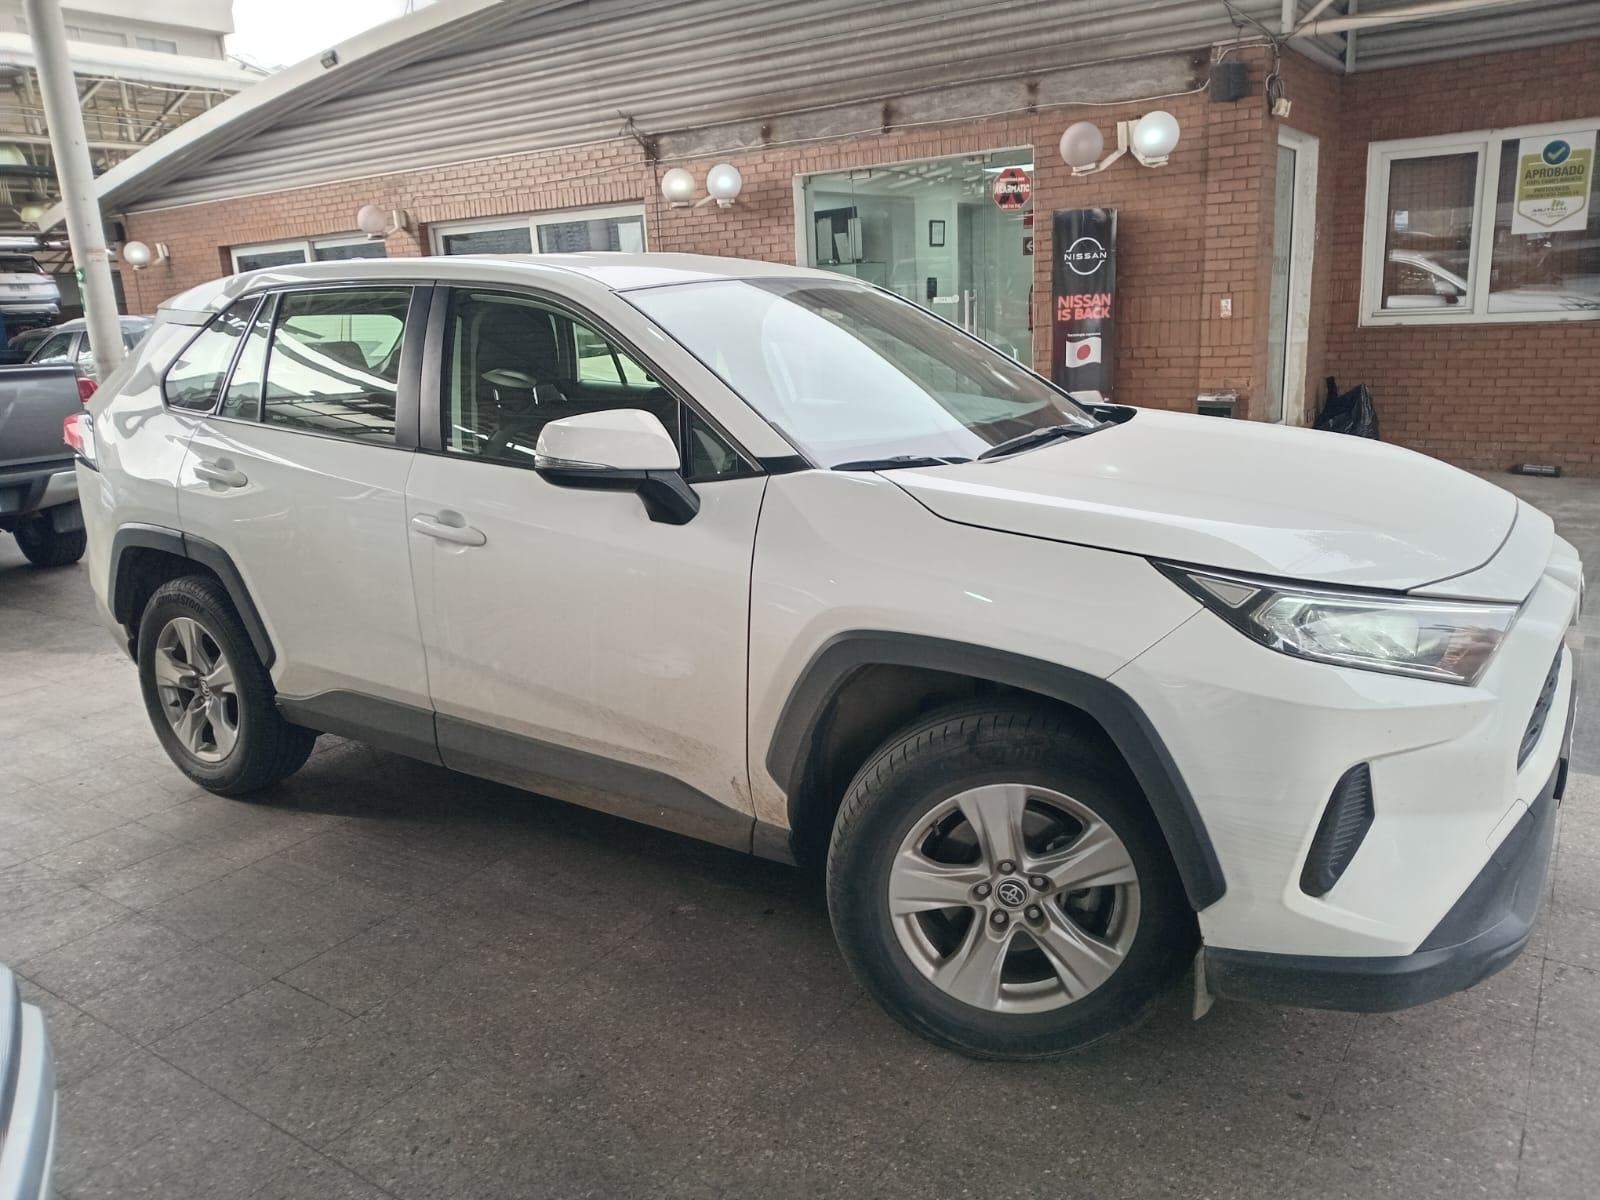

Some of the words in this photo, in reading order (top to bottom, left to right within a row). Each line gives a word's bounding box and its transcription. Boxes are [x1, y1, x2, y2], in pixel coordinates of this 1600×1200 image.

[1524, 165, 1585, 179] APROBADO
[1064, 251, 1107, 261] NISSAN
[1058, 293, 1111, 309] NISSAN
[1057, 308, 1071, 321] IS
[1075, 306, 1110, 320] BACK
